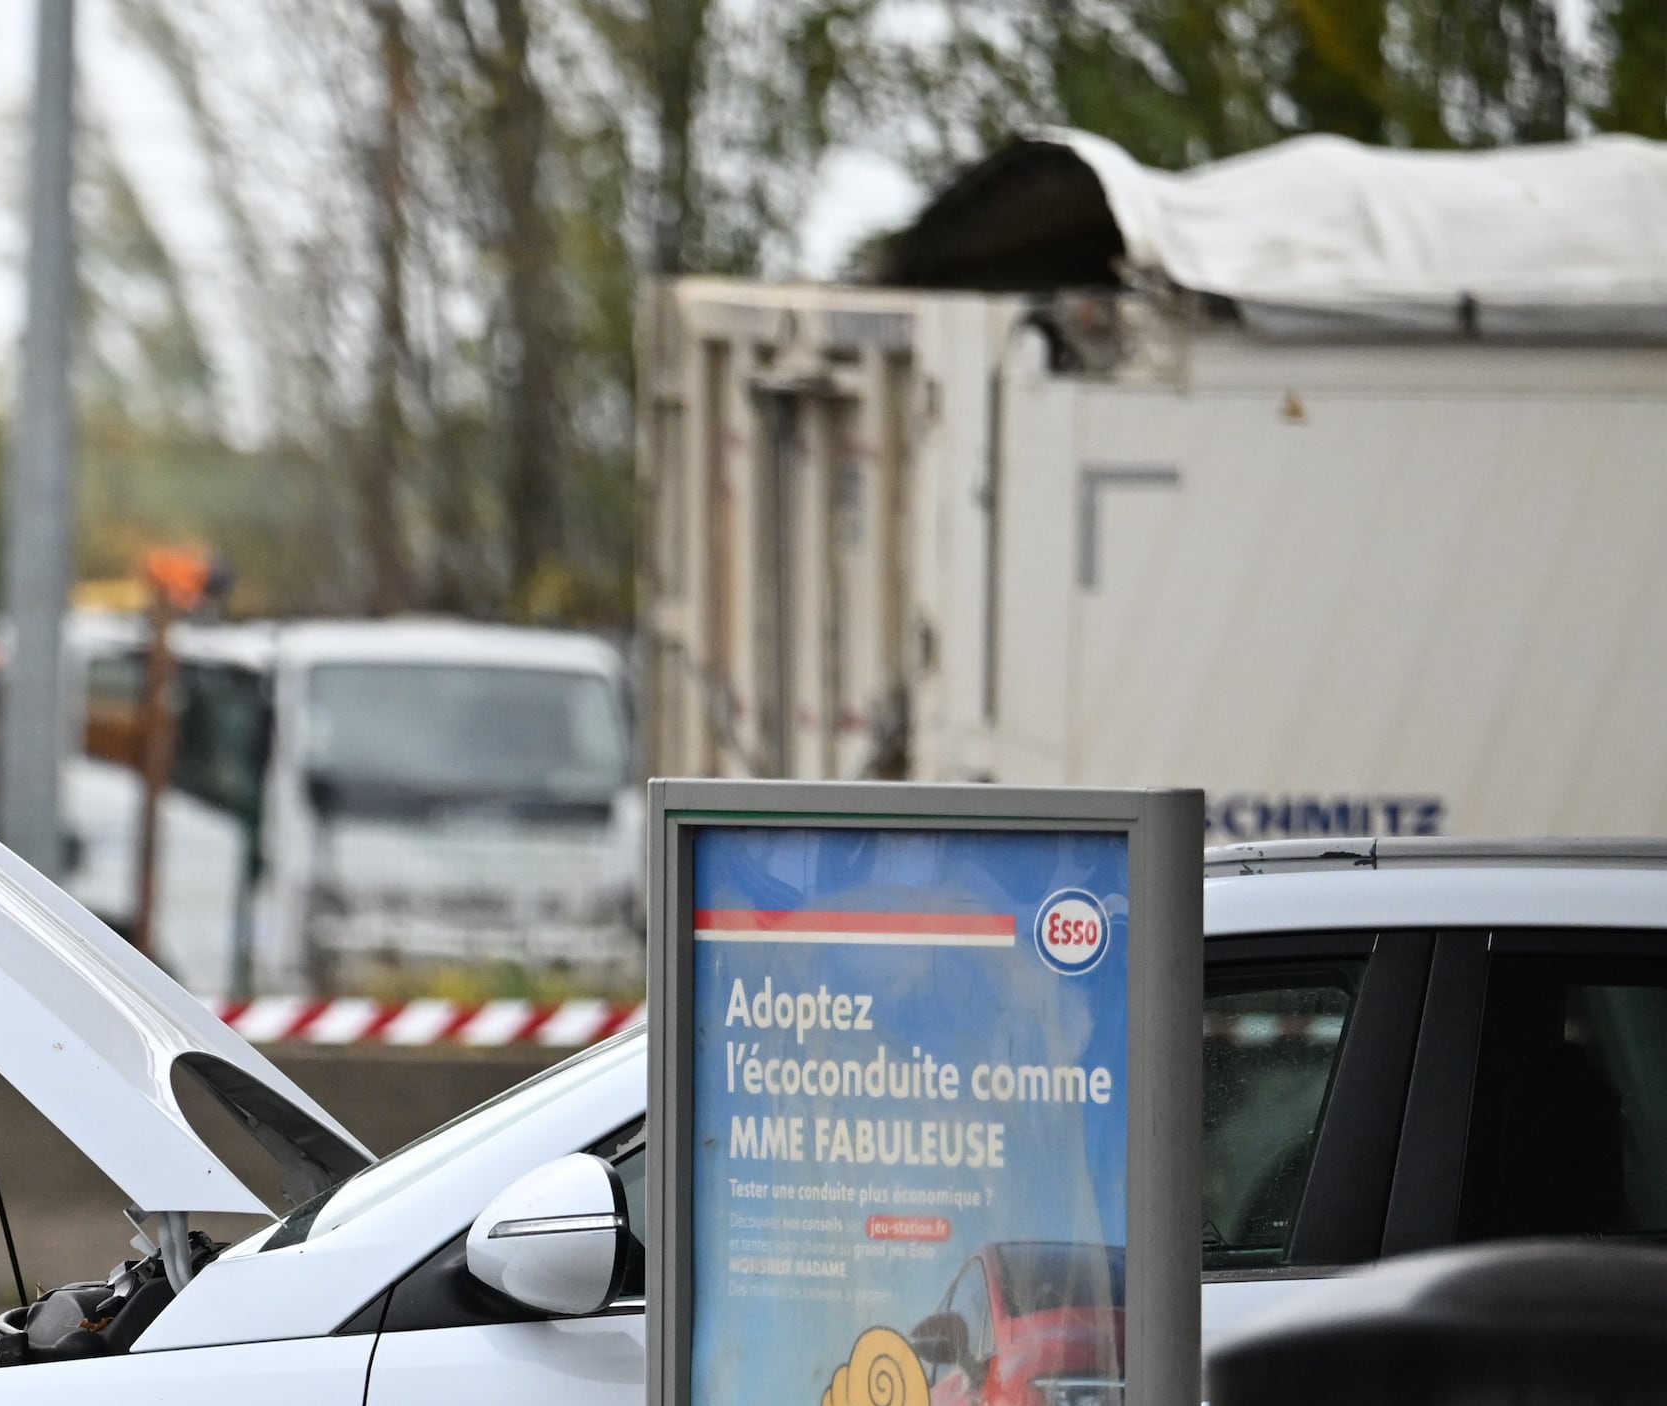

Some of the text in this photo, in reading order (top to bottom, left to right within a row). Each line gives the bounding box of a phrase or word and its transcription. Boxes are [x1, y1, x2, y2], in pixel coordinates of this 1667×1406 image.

[1048, 912, 1097, 945] Esso
[725, 976, 874, 1045] Adoptez
[726, 1041, 1112, 1104] l'écoconduite comme
[729, 1116, 1005, 1168] MME FABULEUSE
[729, 1179, 769, 1199] Tester
[772, 1184, 794, 1199] une
[797, 1182, 856, 1202] conduite
[859, 1184, 889, 1207] plus
[892, 1185, 981, 1210] économique
[802, 1215, 843, 1231] conseils
[869, 1217, 947, 1238] jeu-station.fr
